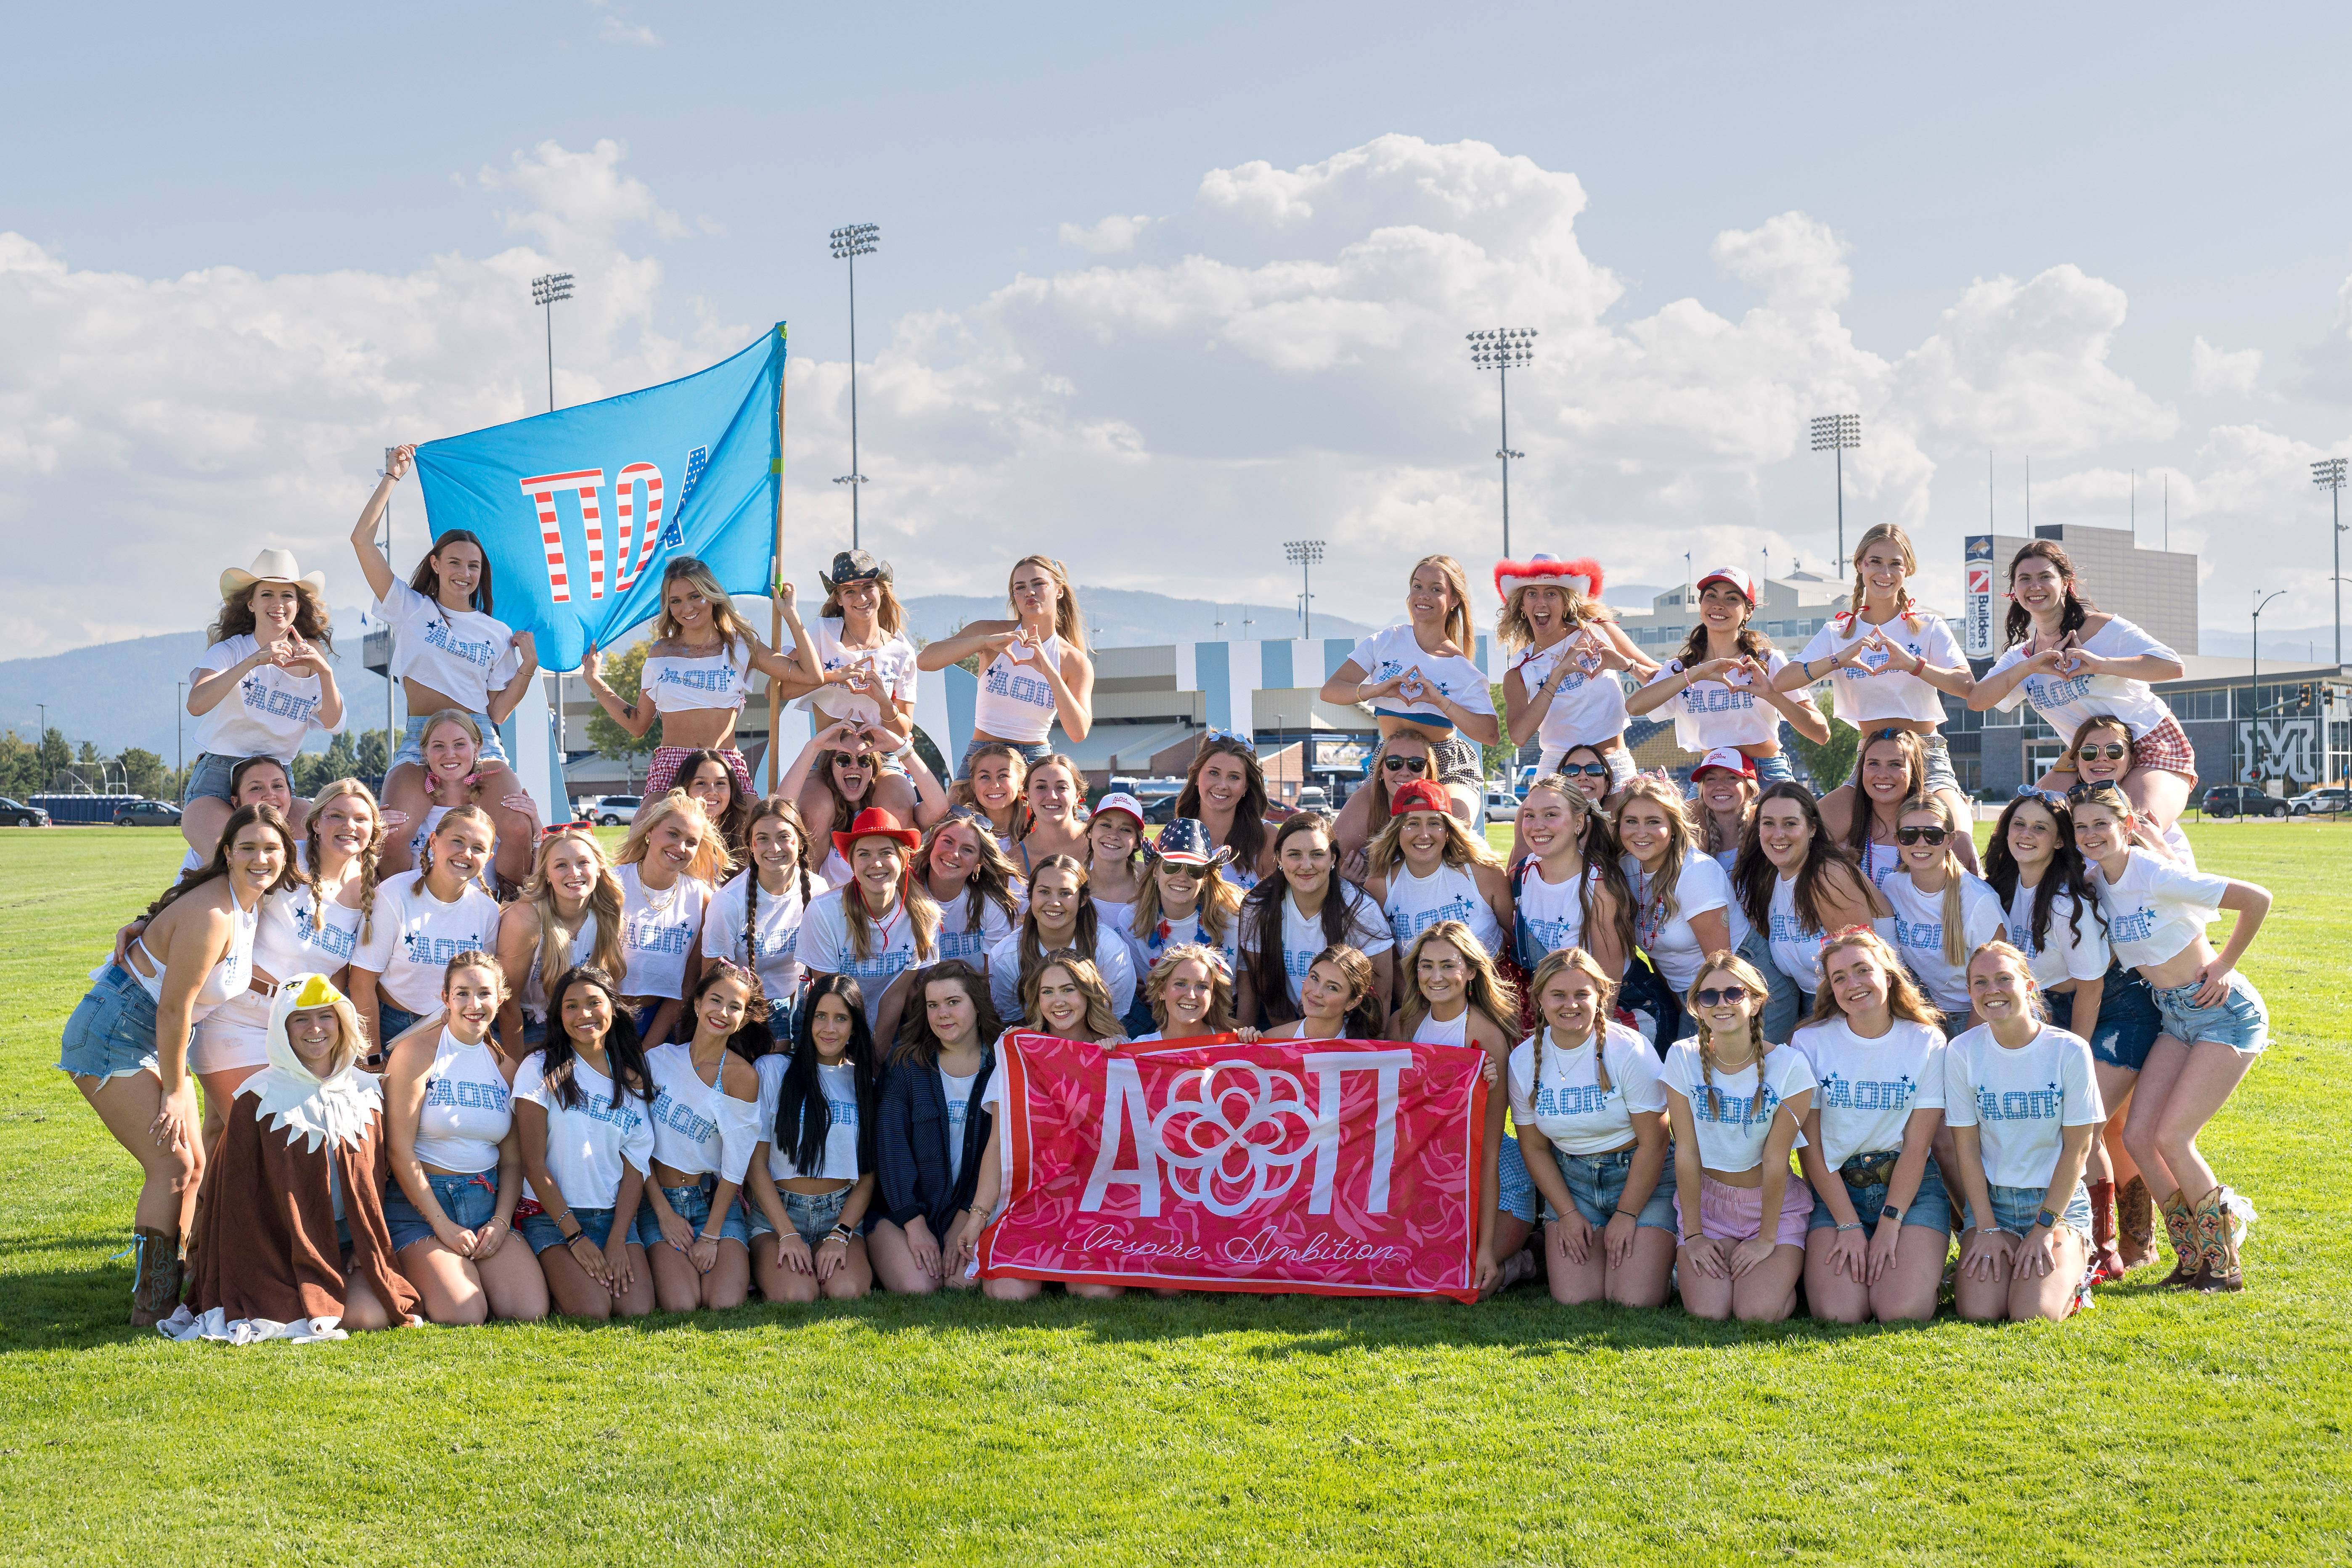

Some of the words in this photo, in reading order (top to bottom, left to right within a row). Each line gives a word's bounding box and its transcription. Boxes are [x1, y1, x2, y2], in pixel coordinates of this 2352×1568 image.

[1978, 595, 1989, 648] Builders
[1062, 1224, 1204, 1260] Inspire
[1224, 1225, 1399, 1265] Ambition
